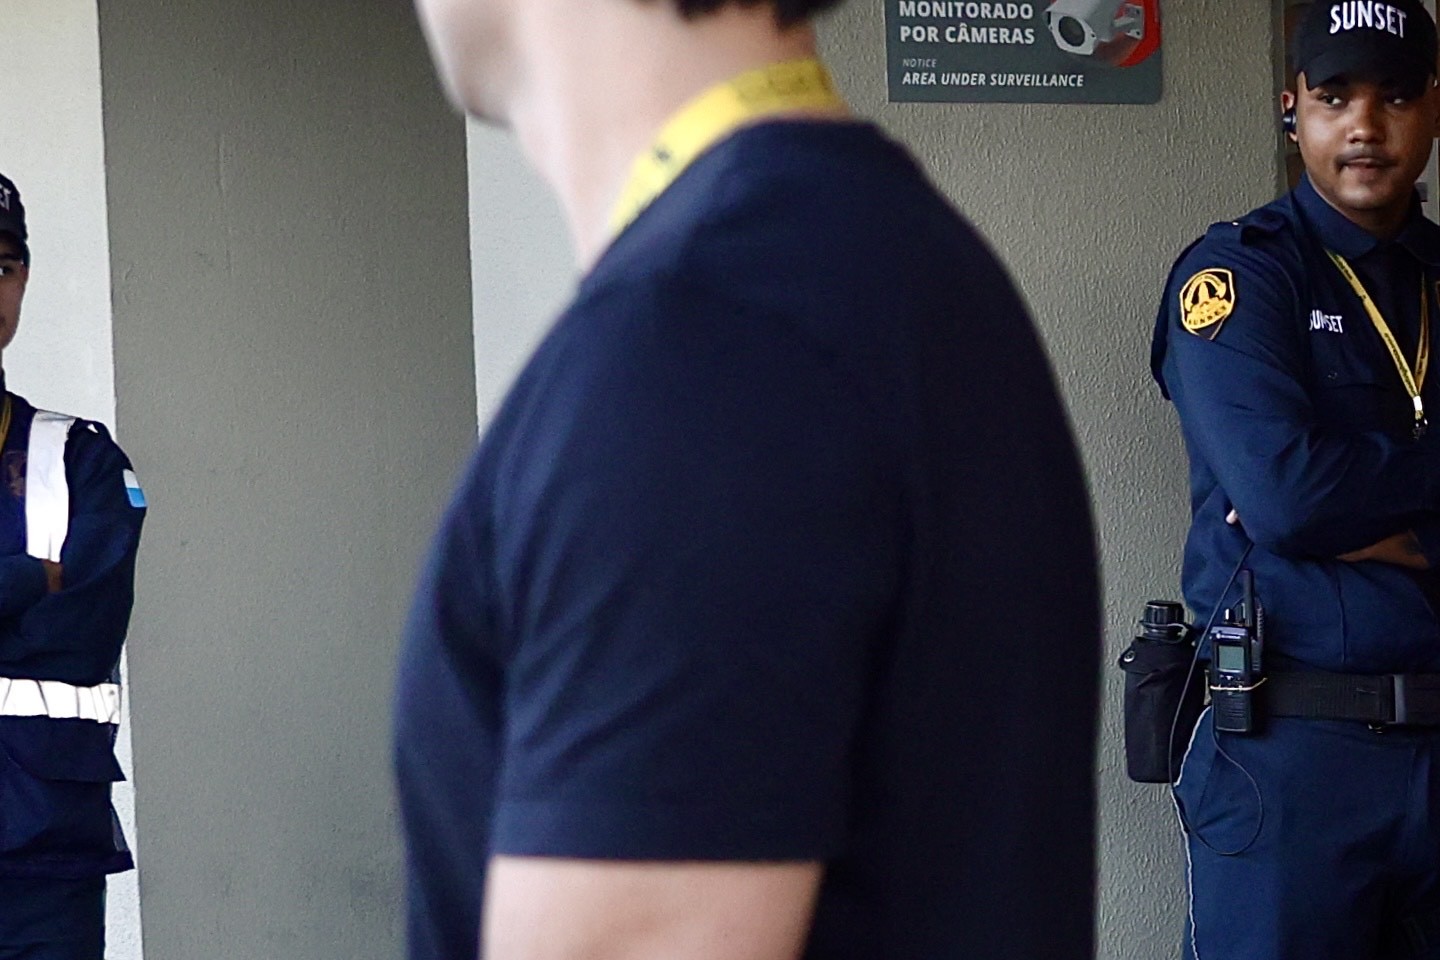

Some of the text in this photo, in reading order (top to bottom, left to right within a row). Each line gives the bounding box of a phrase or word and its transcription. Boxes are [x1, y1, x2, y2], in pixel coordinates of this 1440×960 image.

[899, 0, 1034, 20] MONITORADO
[1329, 0, 1407, 38] SUNSET
[900, 22, 1036, 44] POR CÂMERAS
[902, 58, 938, 68] NOTICE
[902, 72, 1085, 87] AREA UNDER SURVEILLANCE
